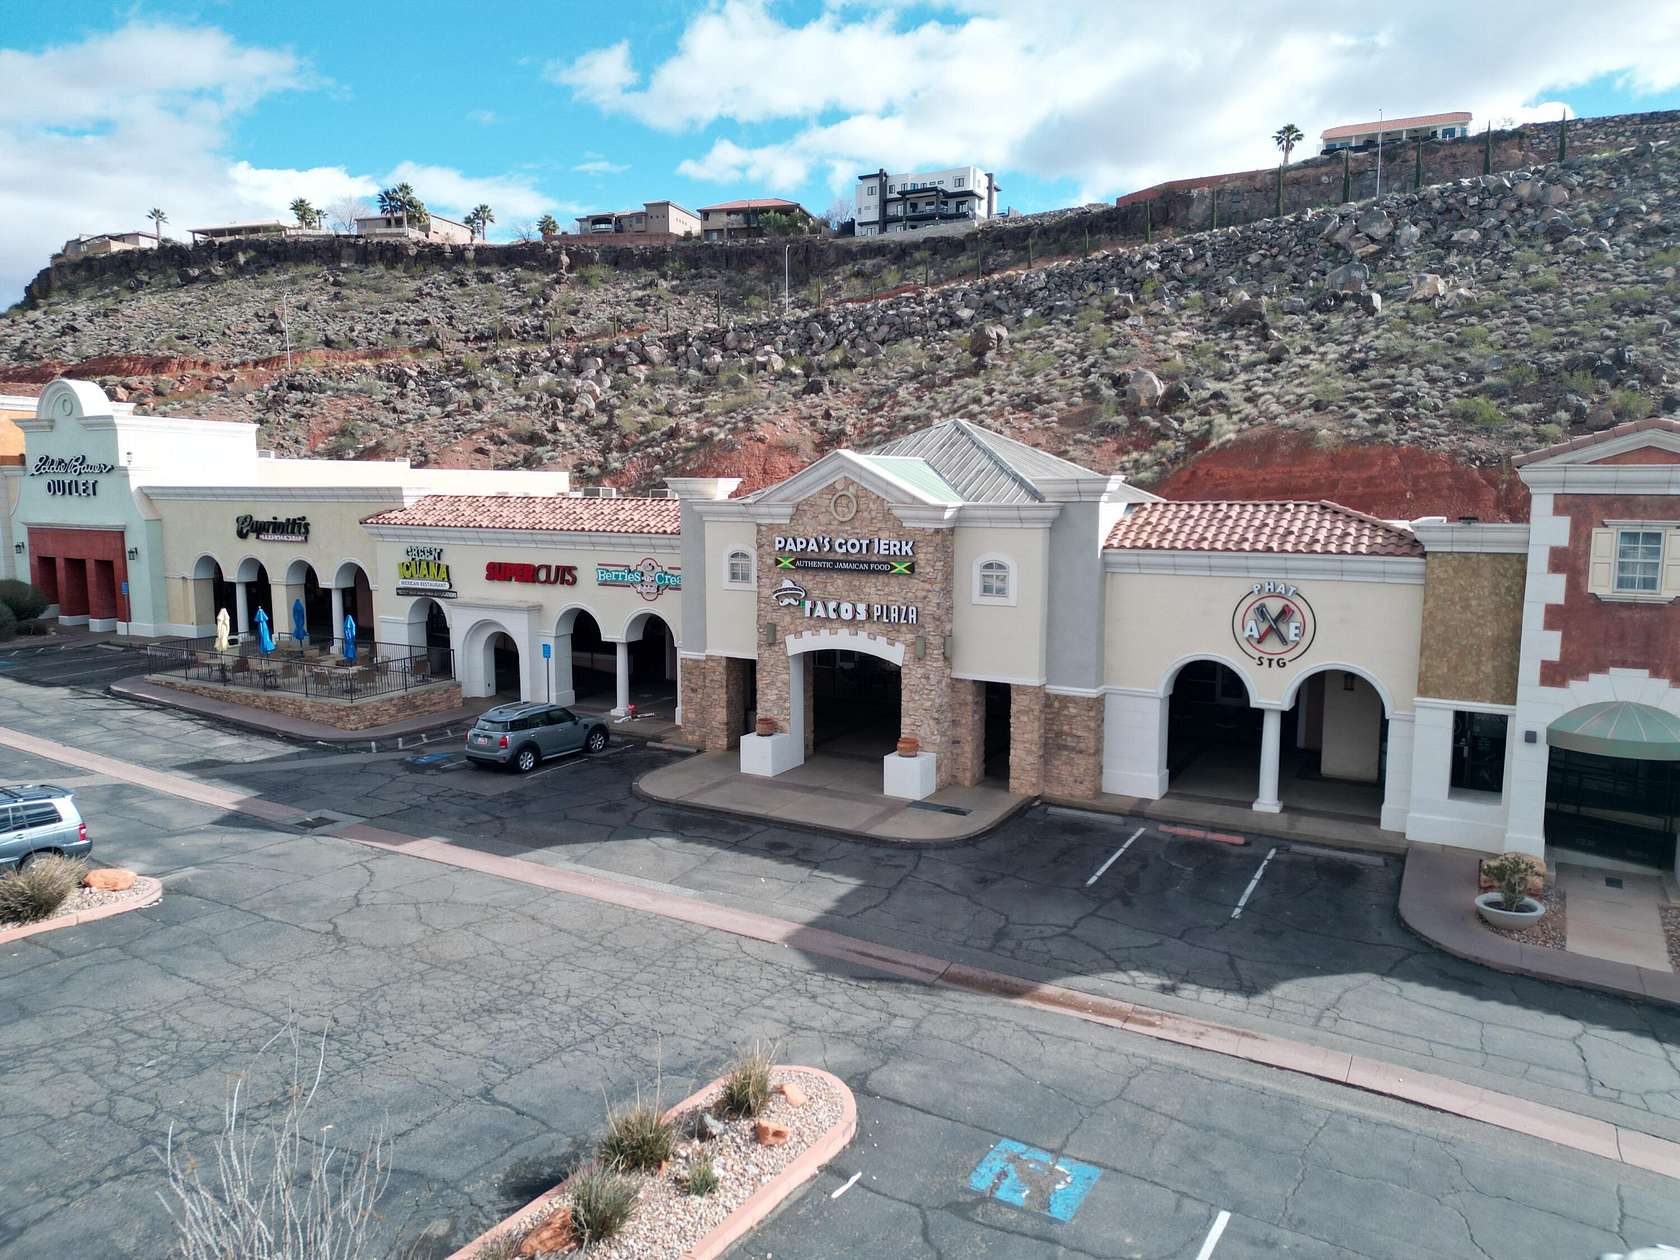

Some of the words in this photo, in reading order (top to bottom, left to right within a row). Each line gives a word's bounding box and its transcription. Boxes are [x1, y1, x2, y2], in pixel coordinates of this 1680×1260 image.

[30, 455, 68, 476] Eddie
[67, 455, 114, 476] Bauer
[46, 479, 98, 496] OUTLET
[774, 536, 831, 553] PAPA'S
[834, 537, 870, 554] GOT
[873, 537, 915, 556] JERK
[398, 560, 449, 581] IGUANA
[485, 562, 578, 586] SUPERCUTS
[795, 560, 834, 569] AUTHENTIC
[834, 561, 869, 570] JAMAICAN
[869, 563, 890, 571] FOOD
[597, 568, 641, 583] Berries
[1252, 580, 1297, 597] PHAT
[802, 600, 868, 621] TACOS
[873, 603, 918, 624] PLAZA
[1256, 656, 1287, 668] STG
